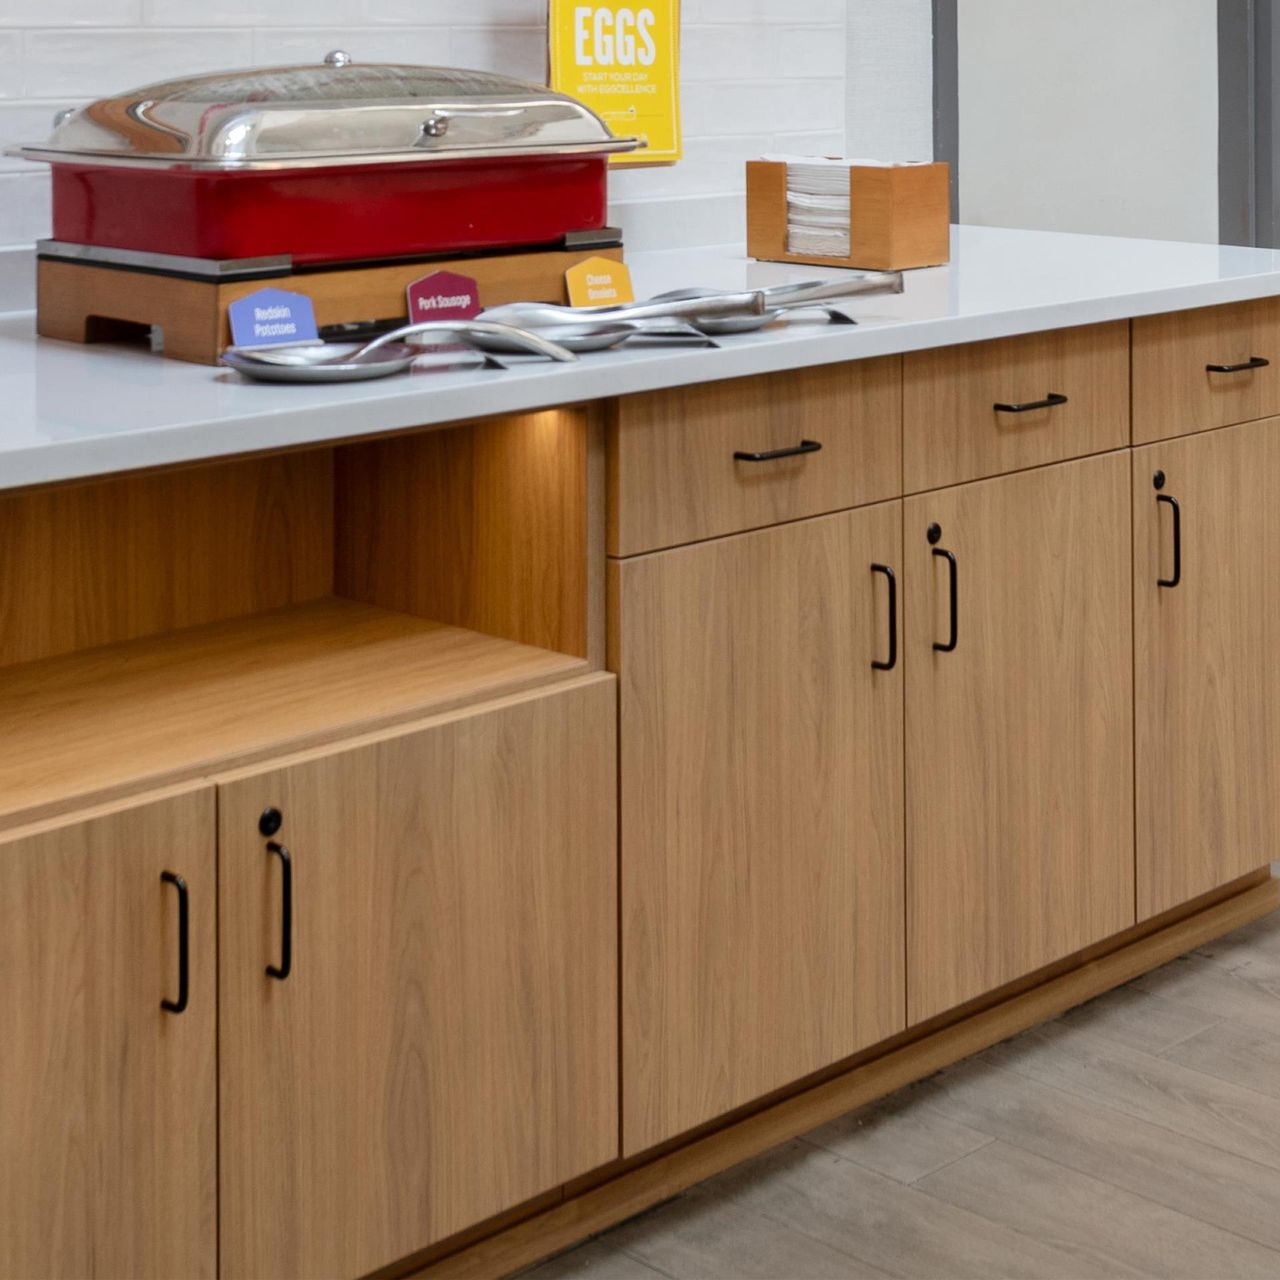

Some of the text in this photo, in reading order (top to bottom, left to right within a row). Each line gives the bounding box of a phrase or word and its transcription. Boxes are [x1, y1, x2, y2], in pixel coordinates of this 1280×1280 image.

[574, 6, 656, 66] EGGS
[583, 72, 648, 82] START YOUR DAY
[576, 84, 598, 94] WITH
[418, 294, 471, 310] Pork Sausage
[254, 305, 291, 320] Redskin
[254, 323, 297, 337] Potatoes
